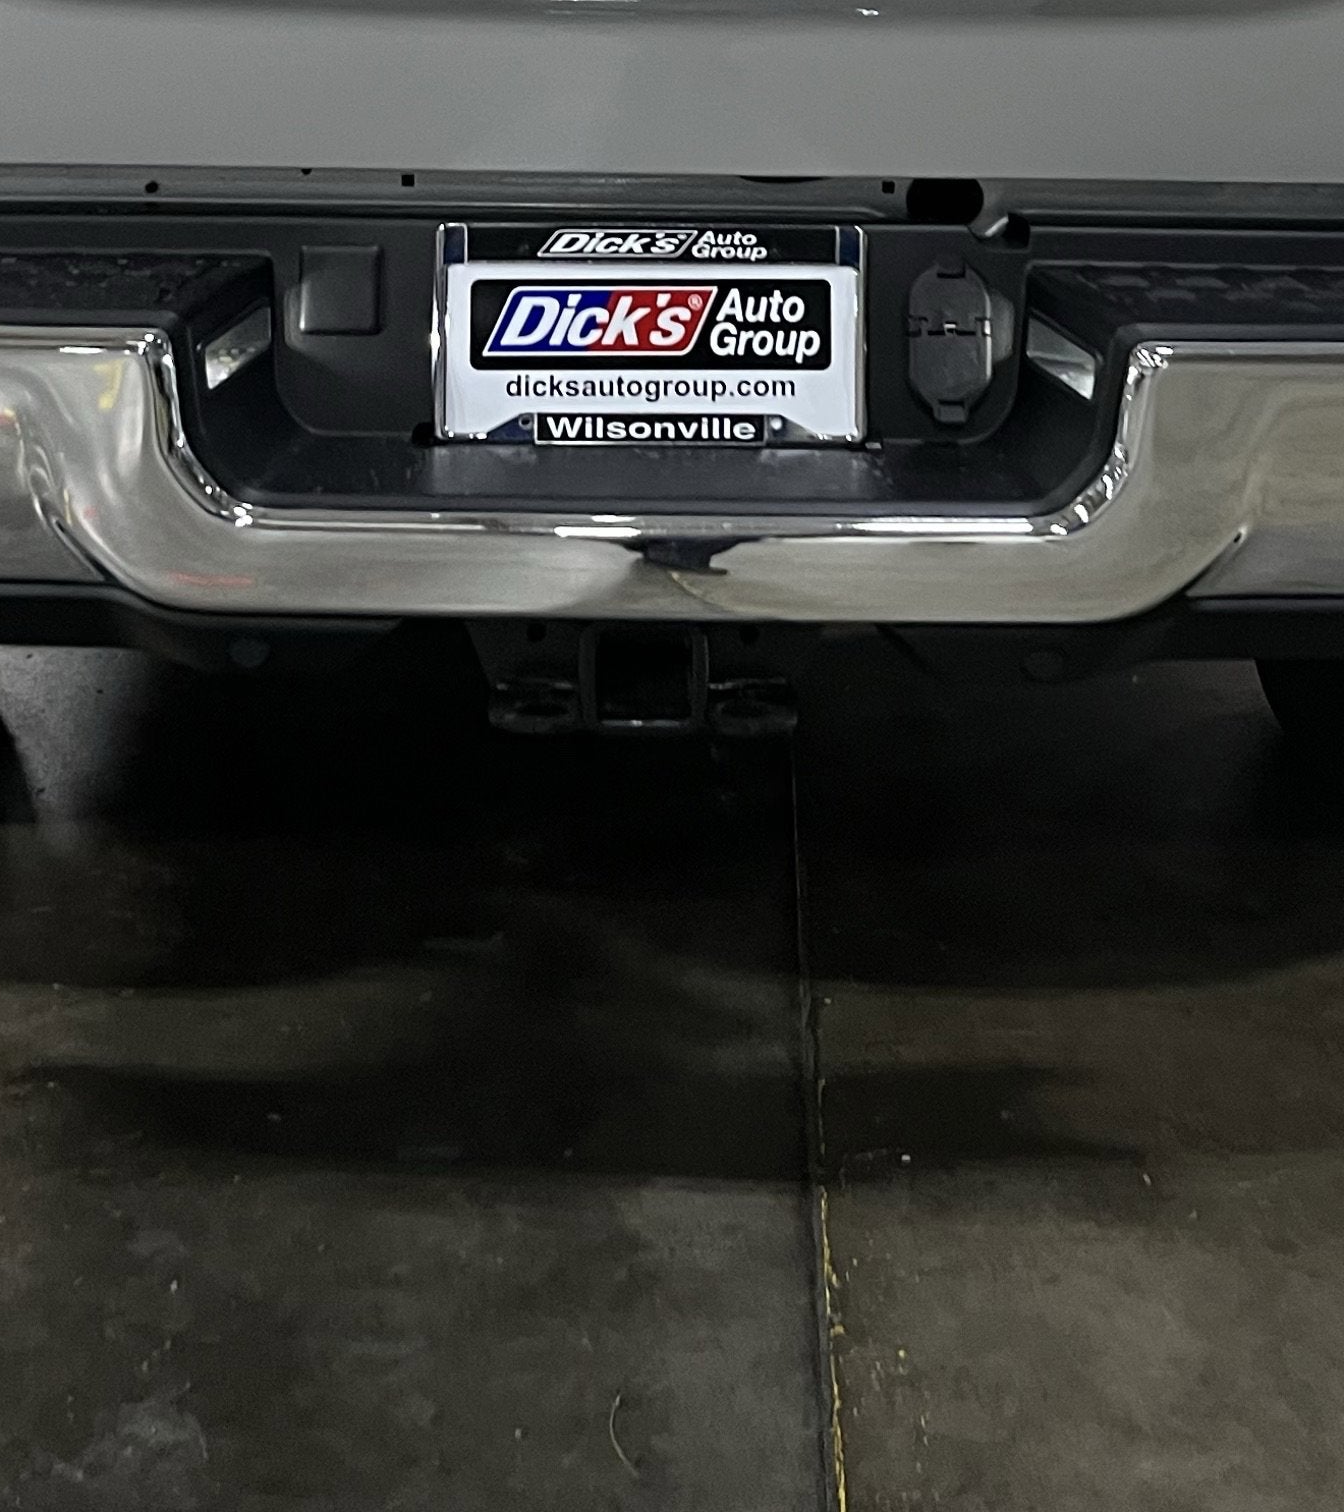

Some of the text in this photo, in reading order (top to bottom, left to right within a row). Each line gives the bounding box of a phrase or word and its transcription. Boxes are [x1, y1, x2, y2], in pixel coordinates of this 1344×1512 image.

[696, 230, 757, 246] Auto
[691, 243, 768, 262] Group
[499, 288, 805, 347] Dick's Auto
[710, 322, 821, 364] Group
[506, 375, 796, 402] dicksautogroup.com
[546, 416, 756, 440] Wilsonville
